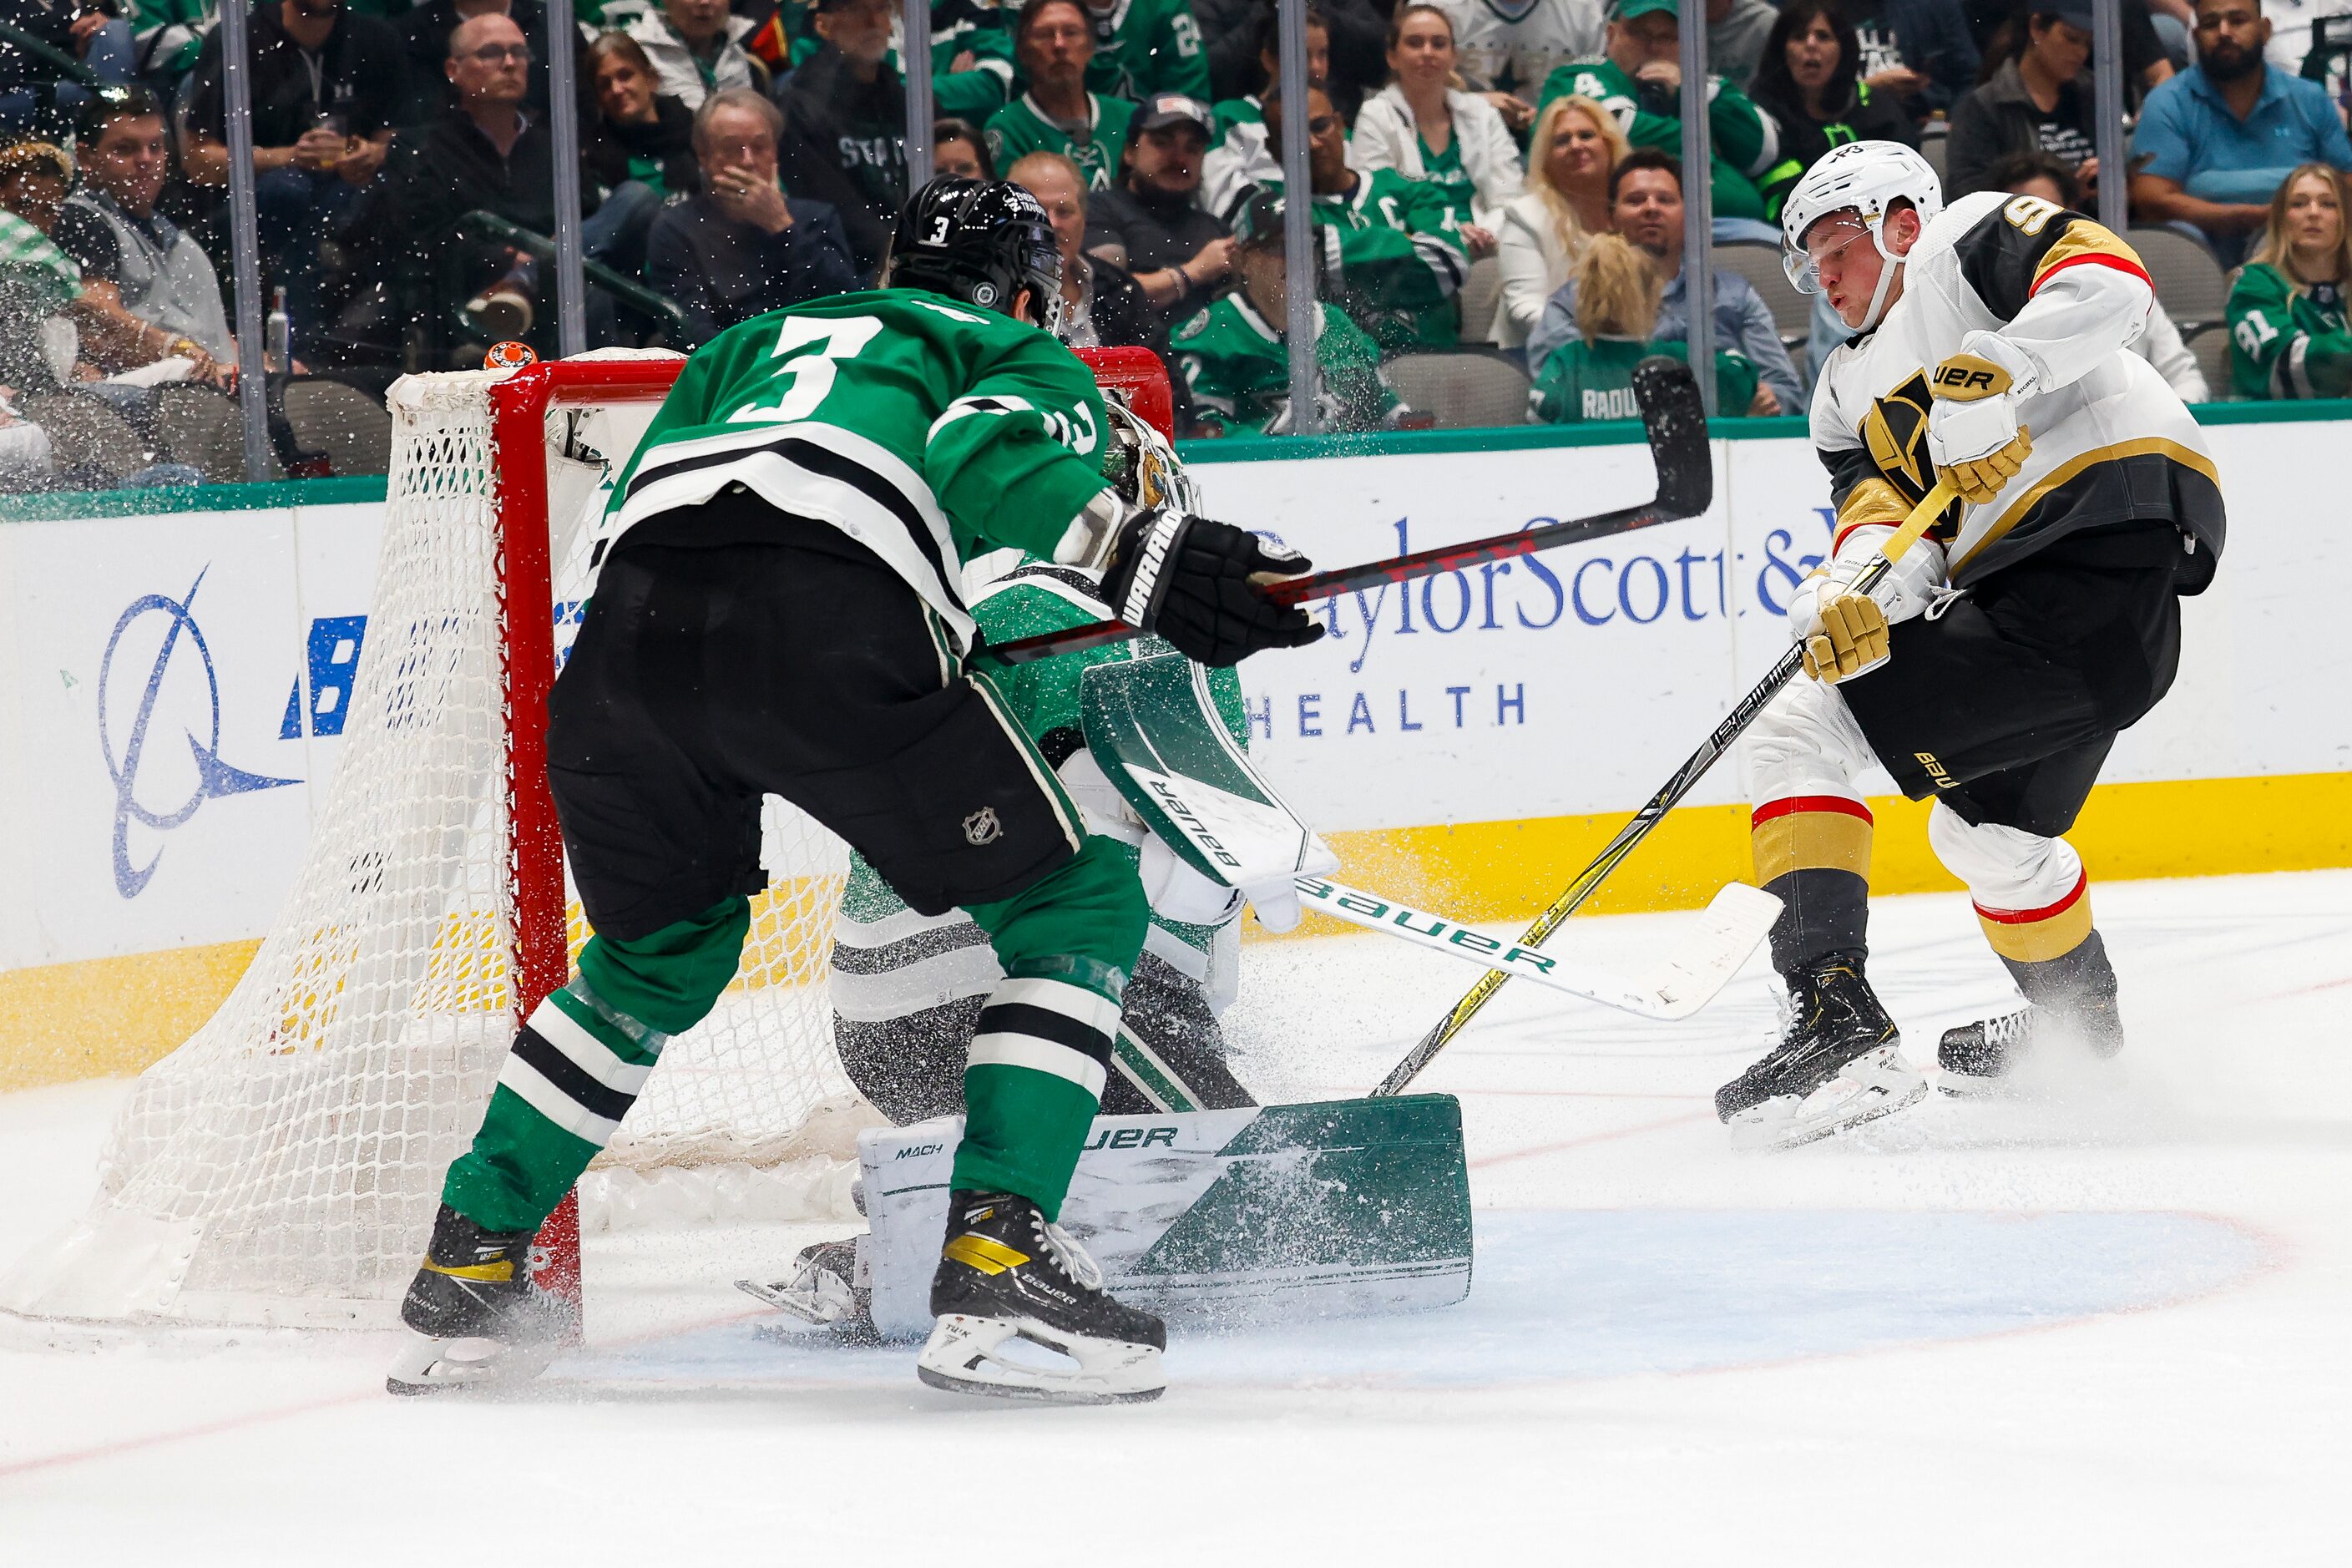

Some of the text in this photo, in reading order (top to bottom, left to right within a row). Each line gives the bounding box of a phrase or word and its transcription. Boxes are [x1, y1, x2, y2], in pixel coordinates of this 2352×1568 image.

[929, 215, 949, 244] 3
[2004, 195, 2066, 237] 9
[2234, 310, 2279, 364] 91
[726, 315, 884, 423] 3
[1582, 387, 1645, 420] RADU
[1121, 508, 1186, 629] WARRIO
[1243, 682, 1525, 740] HEALTH
[895, 1144, 943, 1161] MACH
